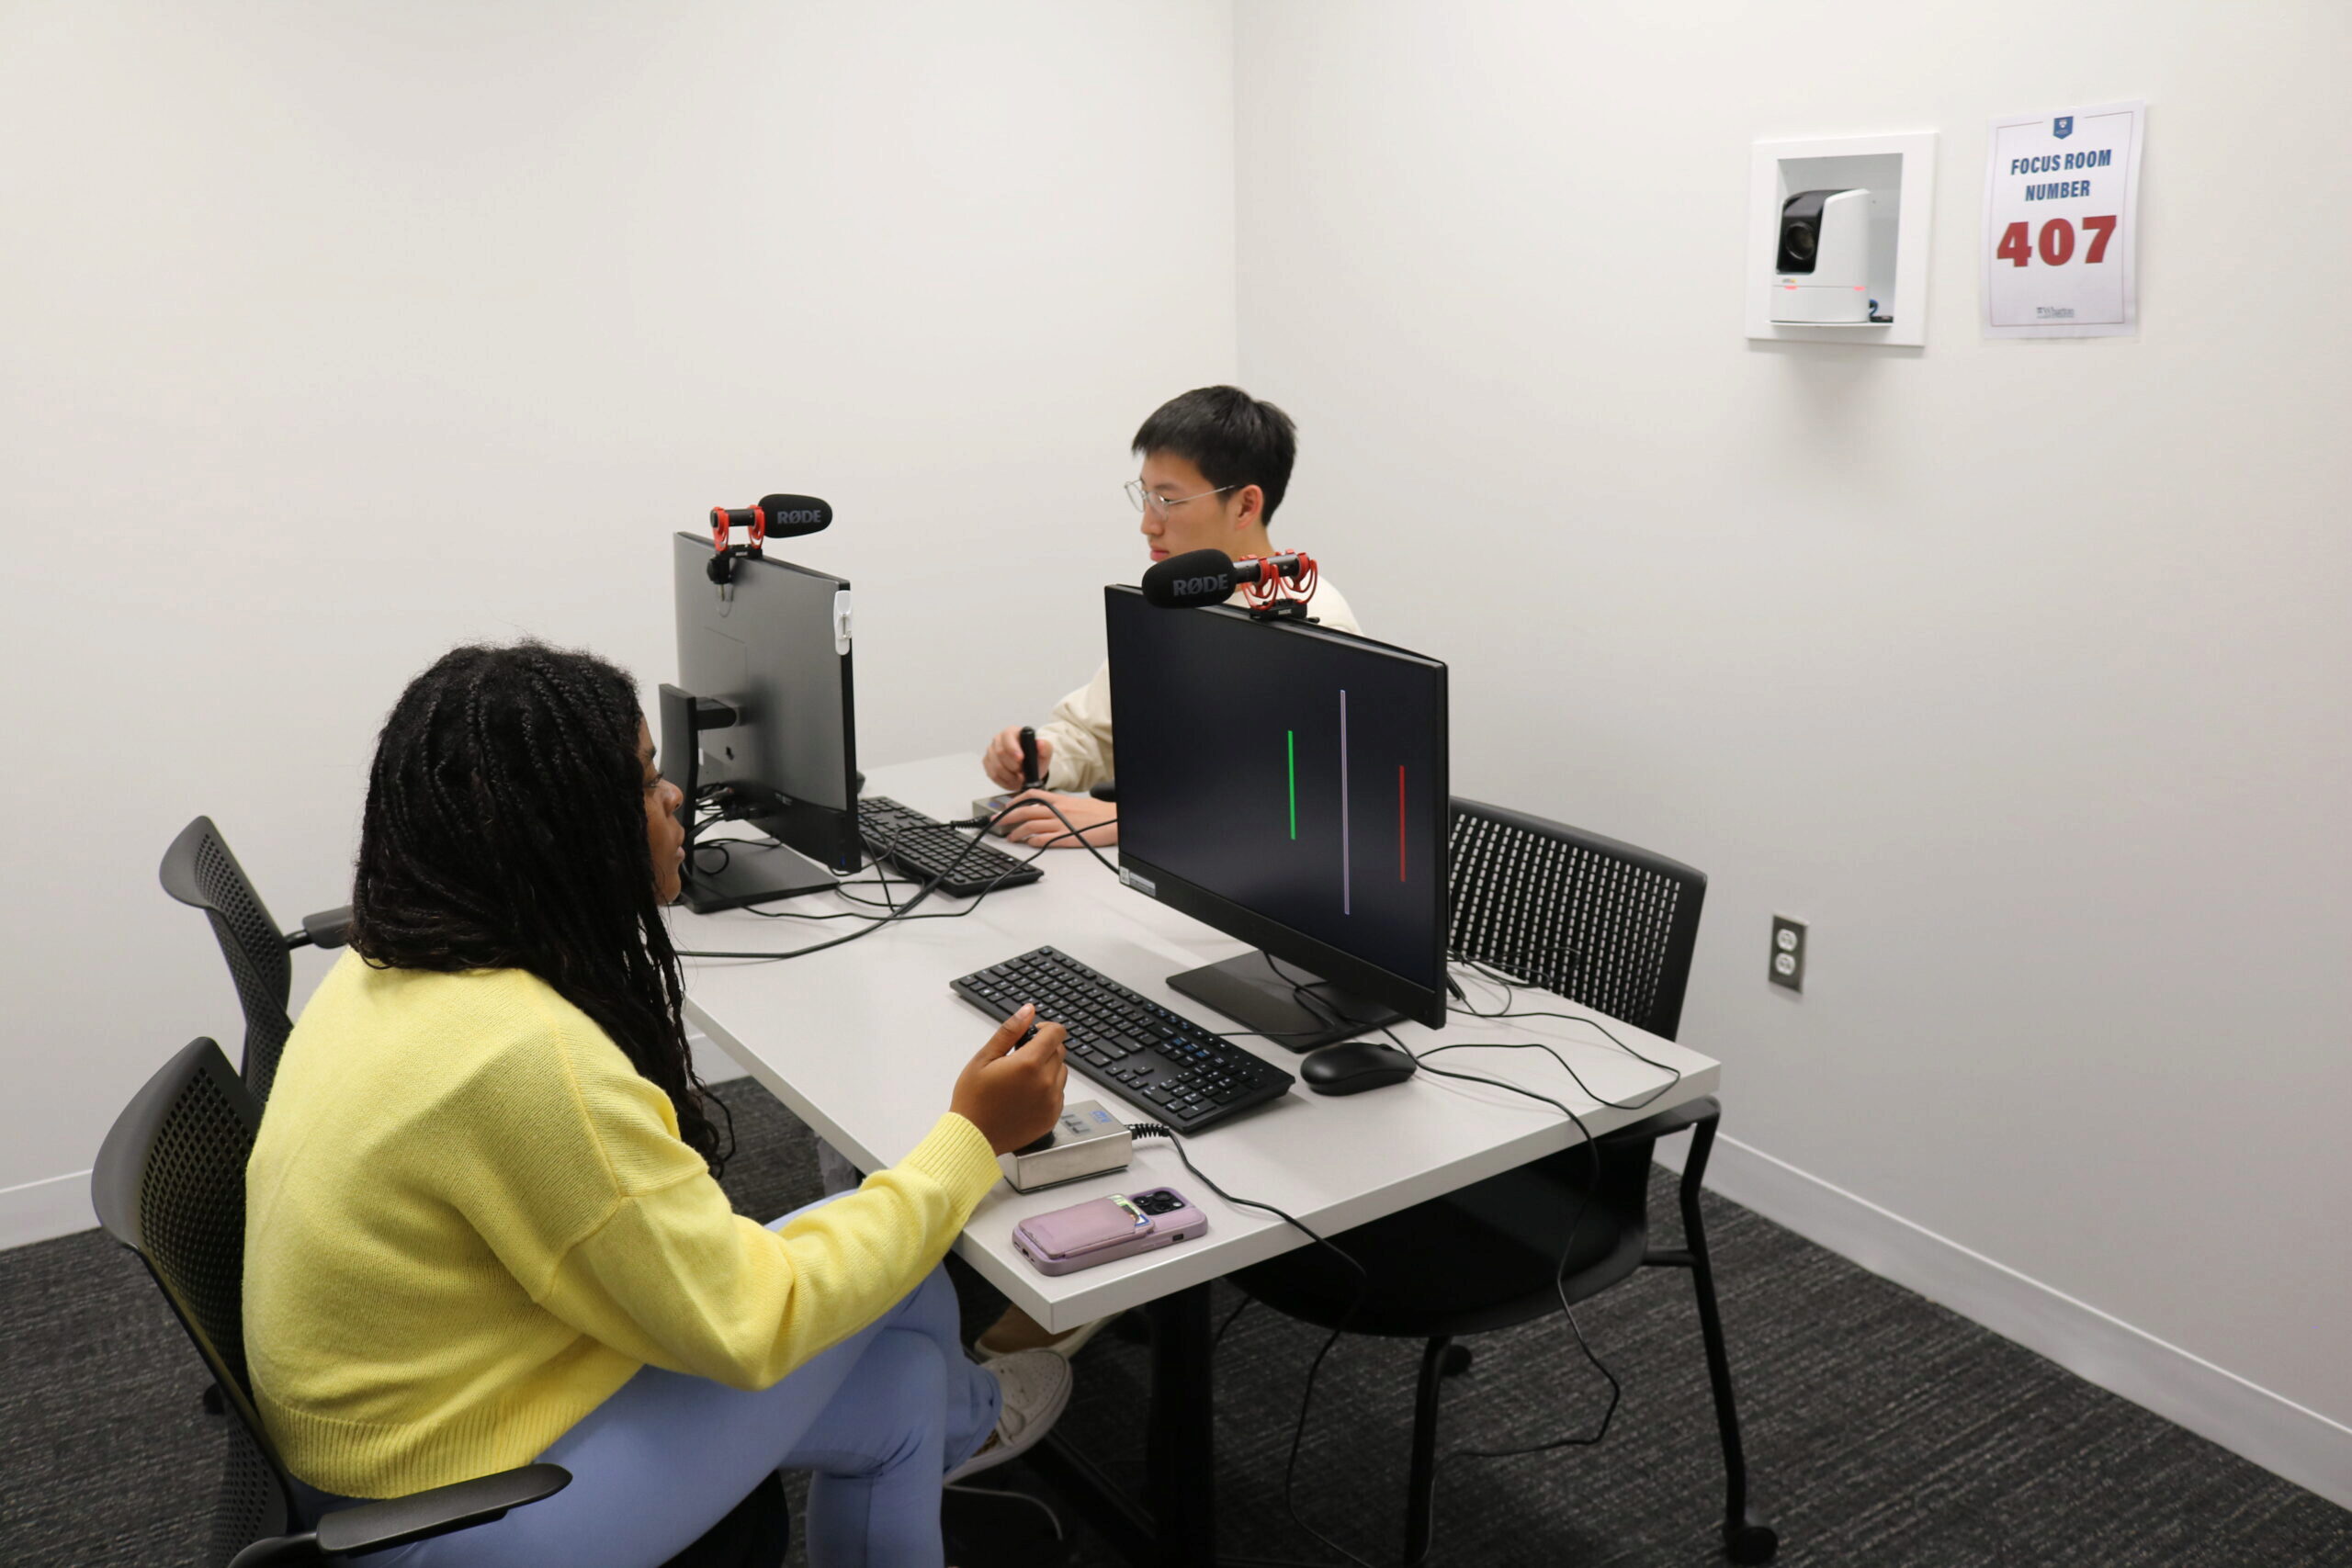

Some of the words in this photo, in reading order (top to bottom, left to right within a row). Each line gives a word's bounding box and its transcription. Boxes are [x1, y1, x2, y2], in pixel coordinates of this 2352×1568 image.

[2011, 154, 2061, 175] FOCUS
[2064, 149, 2112, 170] ROOM
[2025, 180, 2090, 201] NUMBER
[1996, 215, 2117, 267] 407
